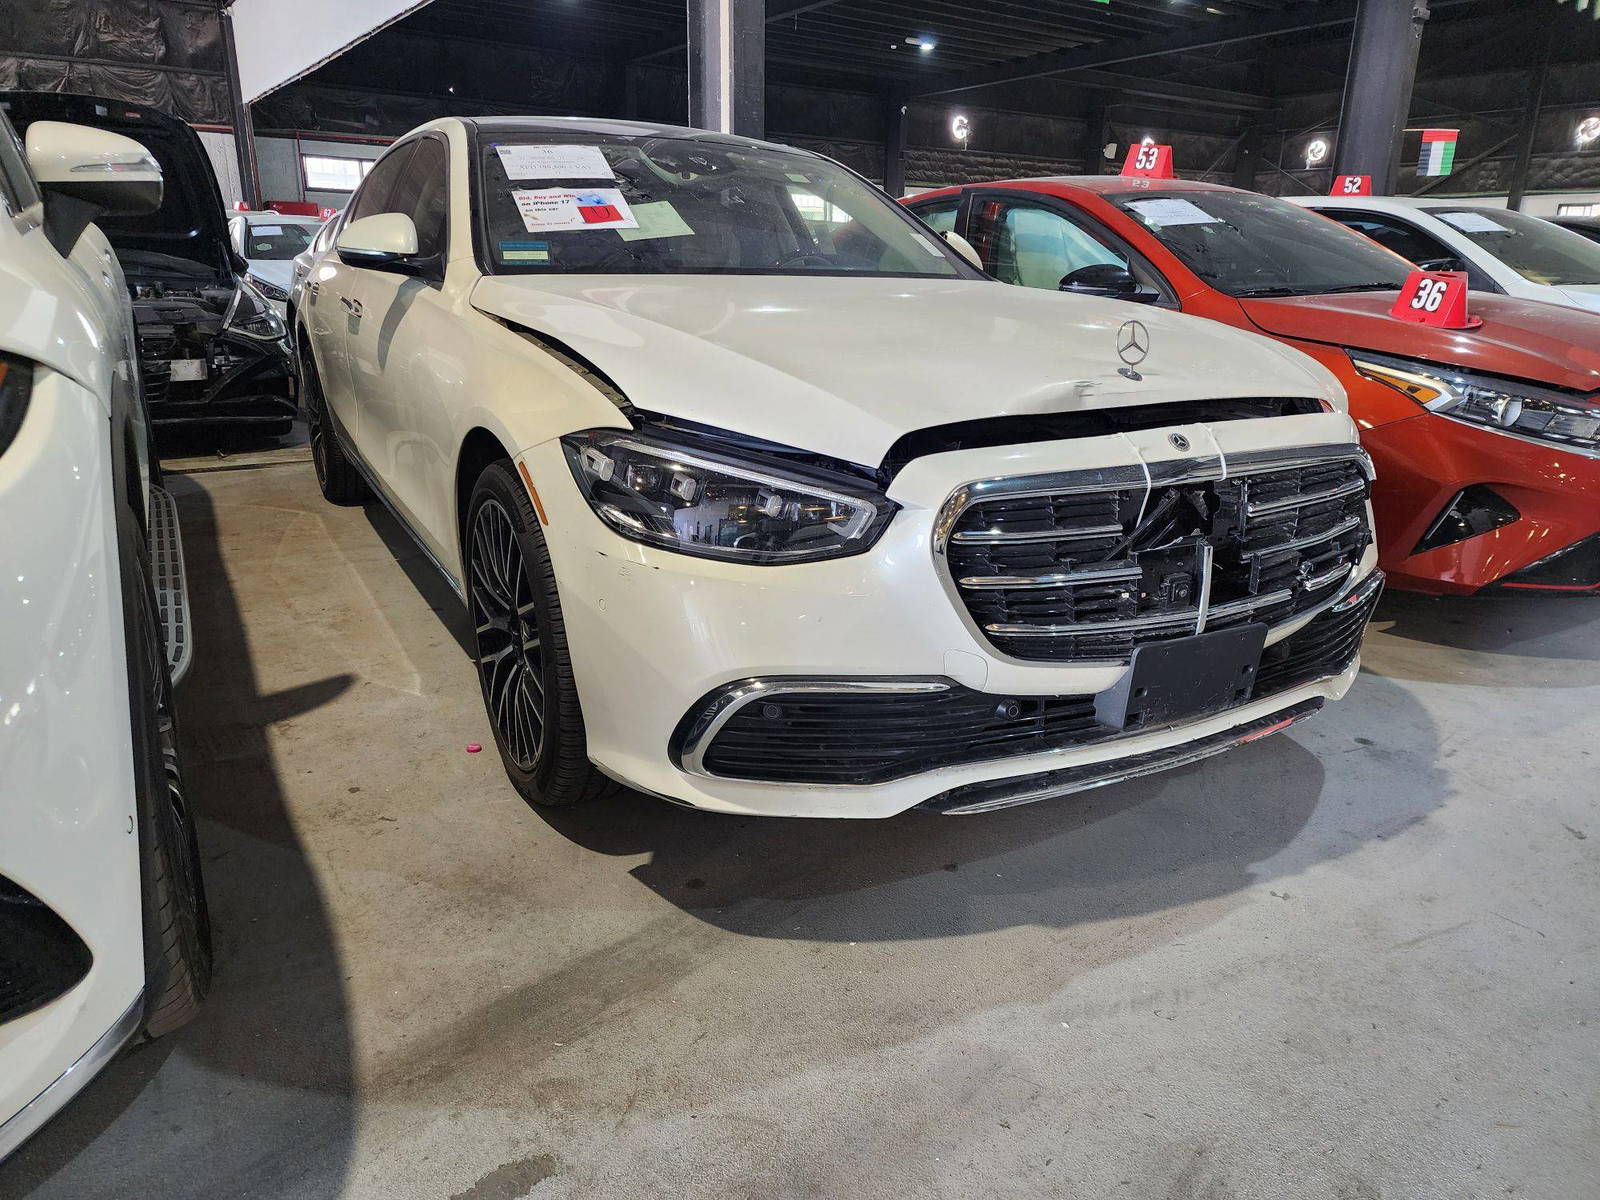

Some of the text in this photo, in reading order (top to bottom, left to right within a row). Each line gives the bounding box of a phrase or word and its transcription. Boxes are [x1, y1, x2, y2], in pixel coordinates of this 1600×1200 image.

[1135, 147, 1159, 169] 53
[1343, 177, 1362, 193] 52
[1411, 279, 1447, 312] 36
